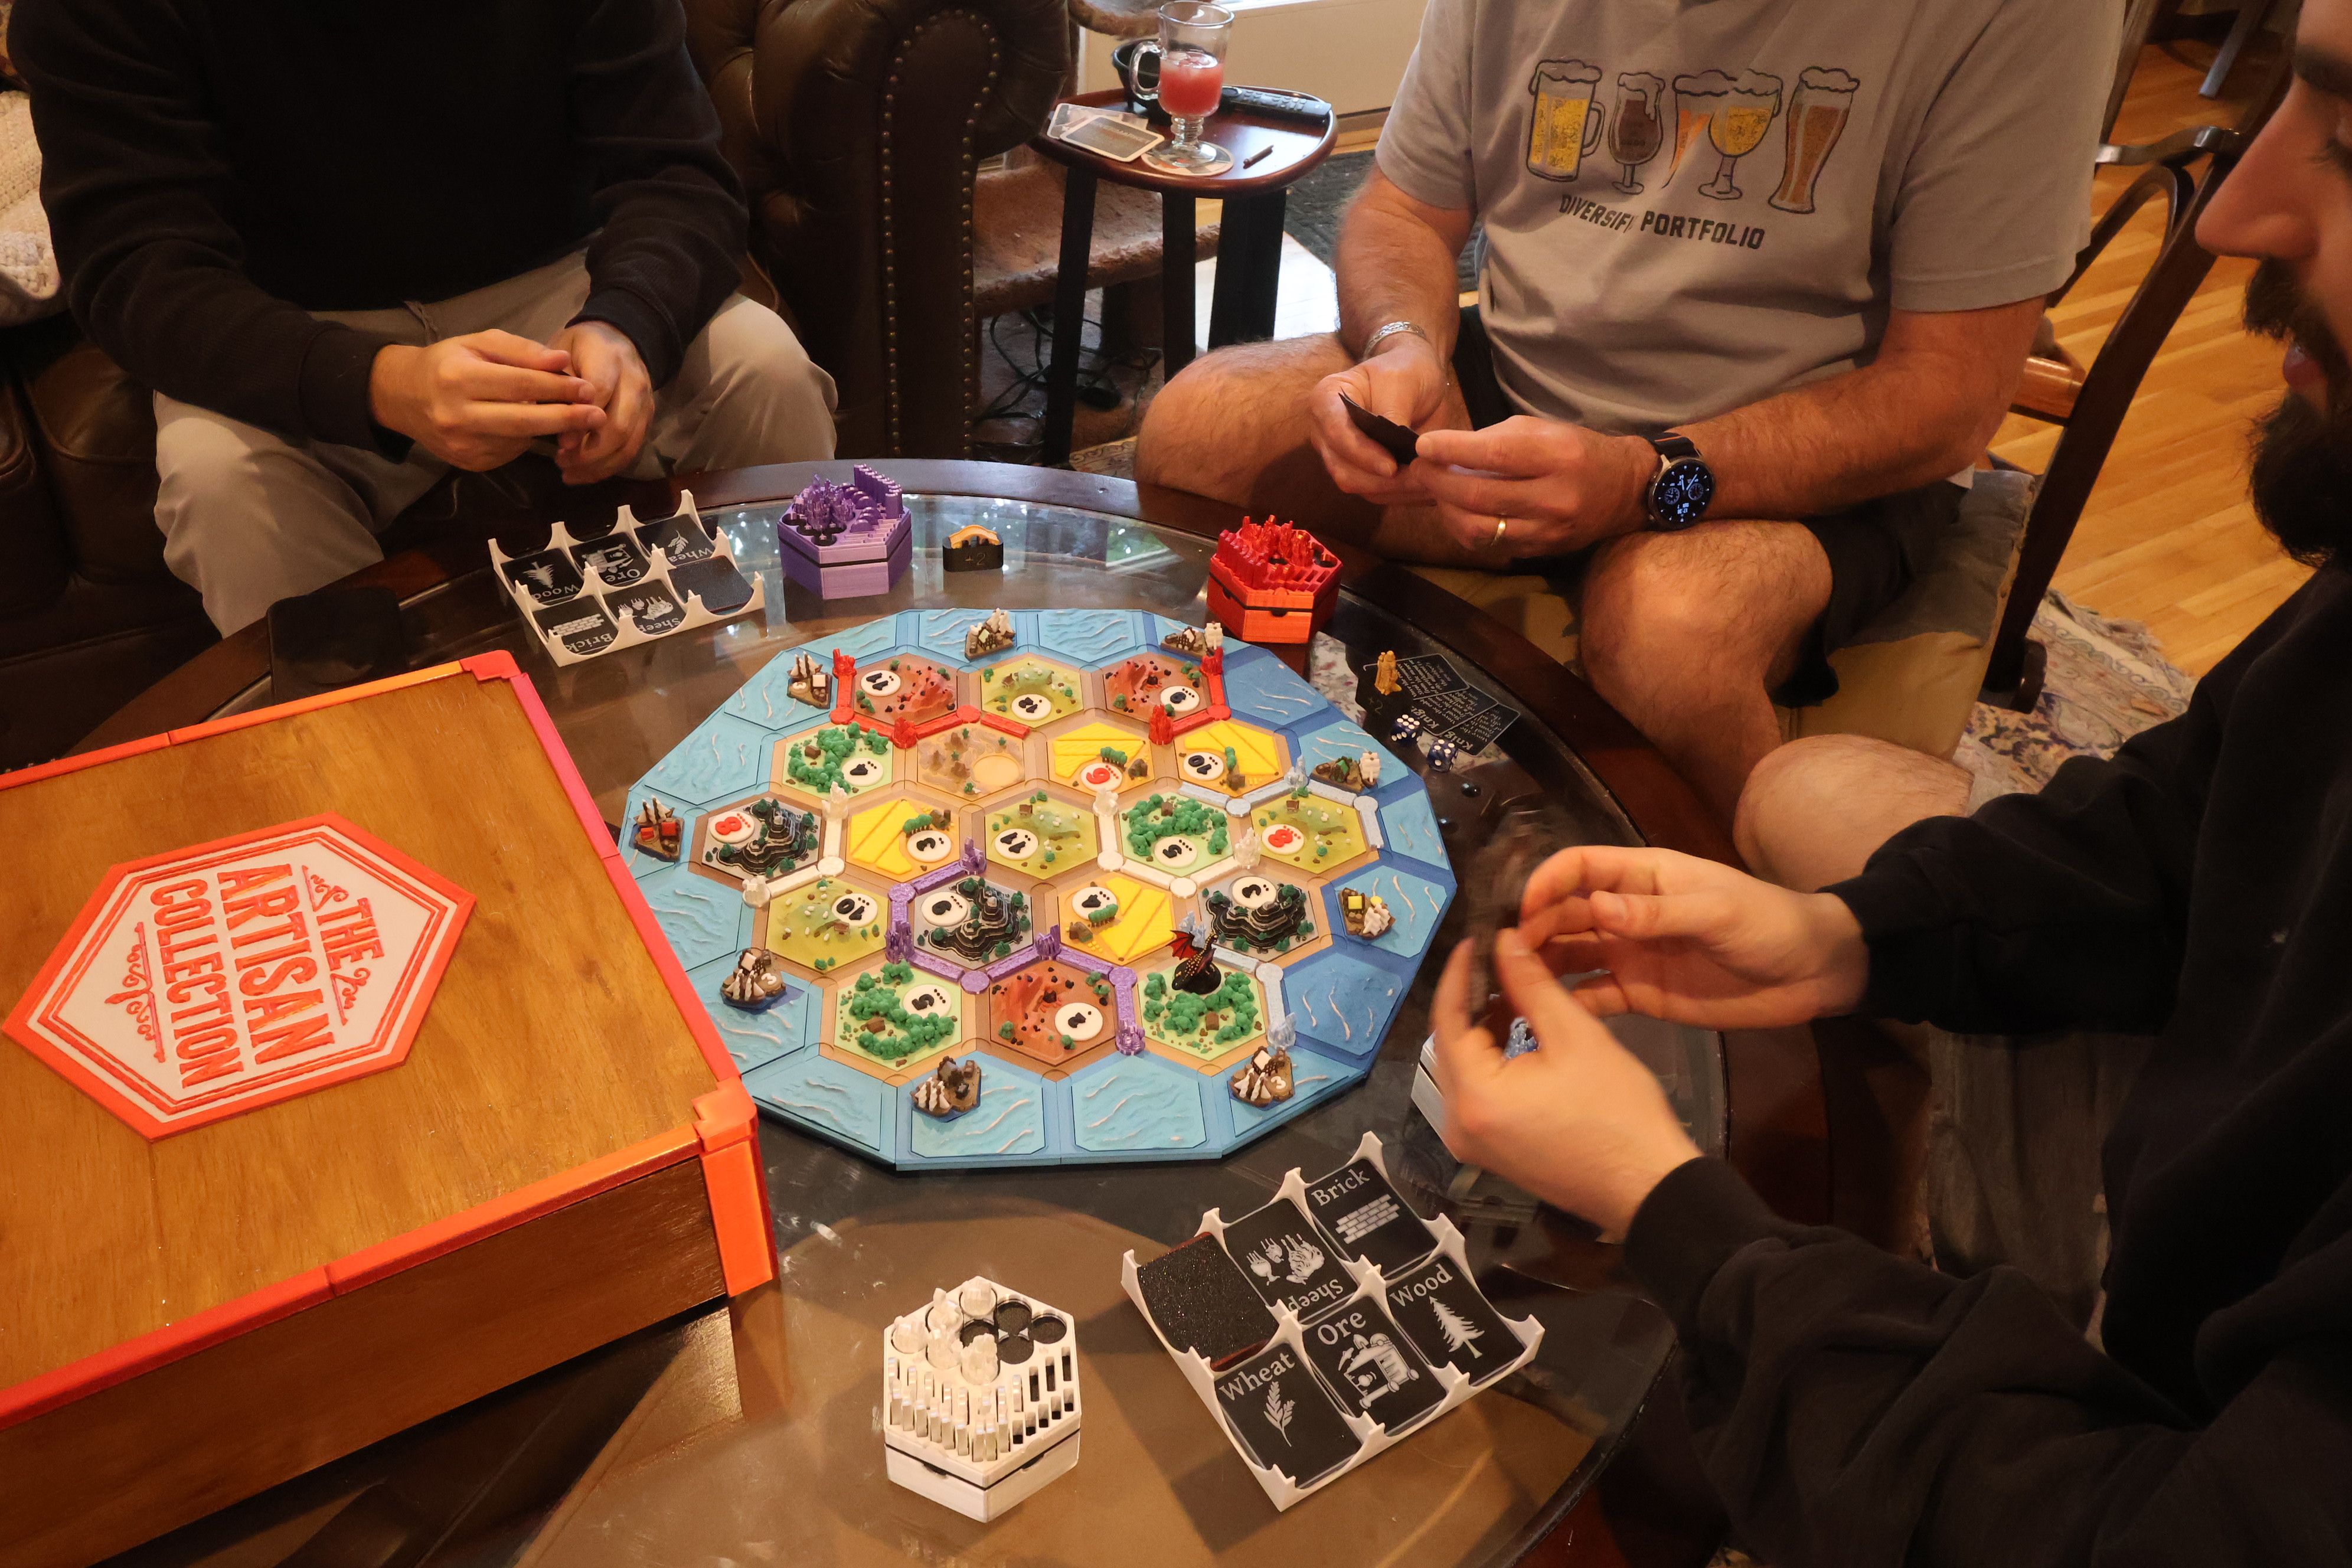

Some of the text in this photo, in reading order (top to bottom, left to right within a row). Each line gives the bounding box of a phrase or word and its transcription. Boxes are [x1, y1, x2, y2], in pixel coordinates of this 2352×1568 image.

[1640, 211, 1765, 249] PORTFOLIO
[668, 548, 713, 562] Whea
[605, 569, 640, 582] Ore
[1444, 731, 1474, 750] Knig
[1188, 755, 1211, 775] 10
[716, 816, 742, 835] 8
[916, 837, 936, 851] 3
[1268, 829, 1293, 848] 8
[1162, 844, 1182, 858] 5
[1242, 883, 1262, 899] 3
[835, 899, 865, 921] 10
[316, 897, 383, 970] THE
[216, 863, 335, 1065] ARTISAN
[150, 878, 244, 1089] COLLECTION
[761, 973, 777, 985] 3
[910, 994, 935, 1011] 5
[1270, 1076, 1286, 1090] 3
[1311, 1169, 1371, 1207] Brick
[1288, 1279, 1344, 1312] Sheep
[1389, 1264, 1453, 1308] Wood
[1318, 1313, 1366, 1345] Ore
[1219, 1351, 1295, 1403] Wheat
